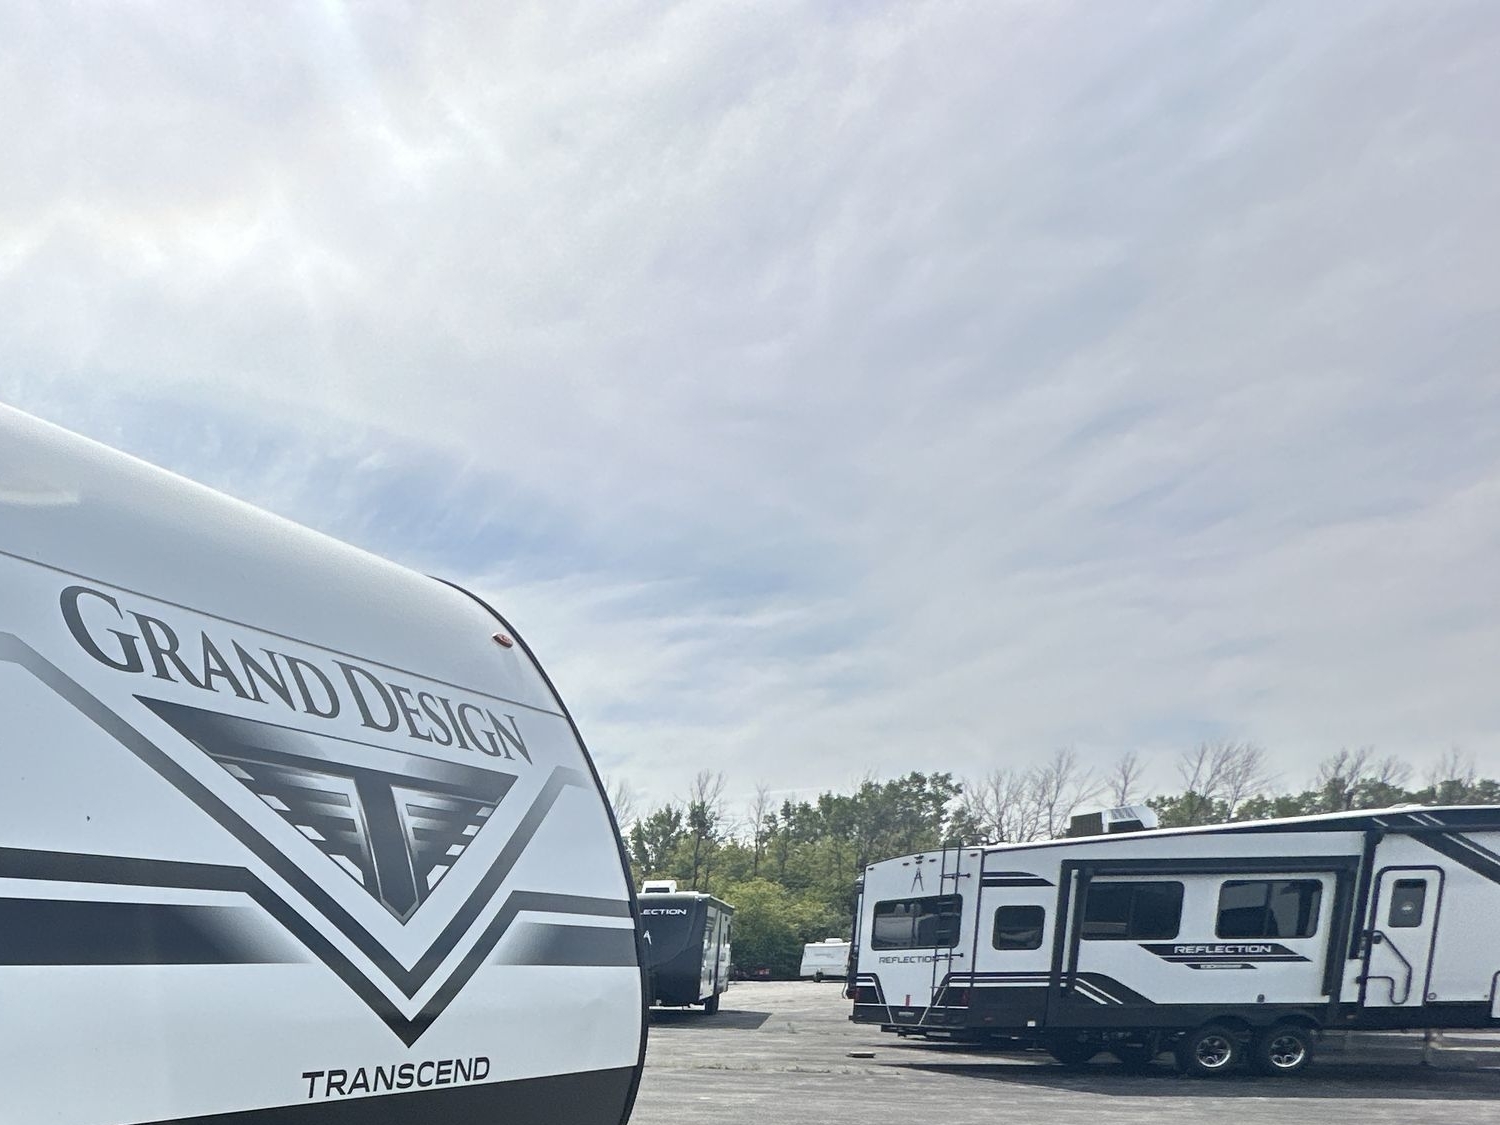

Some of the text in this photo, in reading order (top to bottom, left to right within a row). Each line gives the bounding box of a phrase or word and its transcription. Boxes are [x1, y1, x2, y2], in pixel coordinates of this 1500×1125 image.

[59, 586, 533, 765] GRAND DESIGN
[1173, 944, 1272, 954] REFLECTION
[301, 1056, 491, 1099] TRANSCEND
